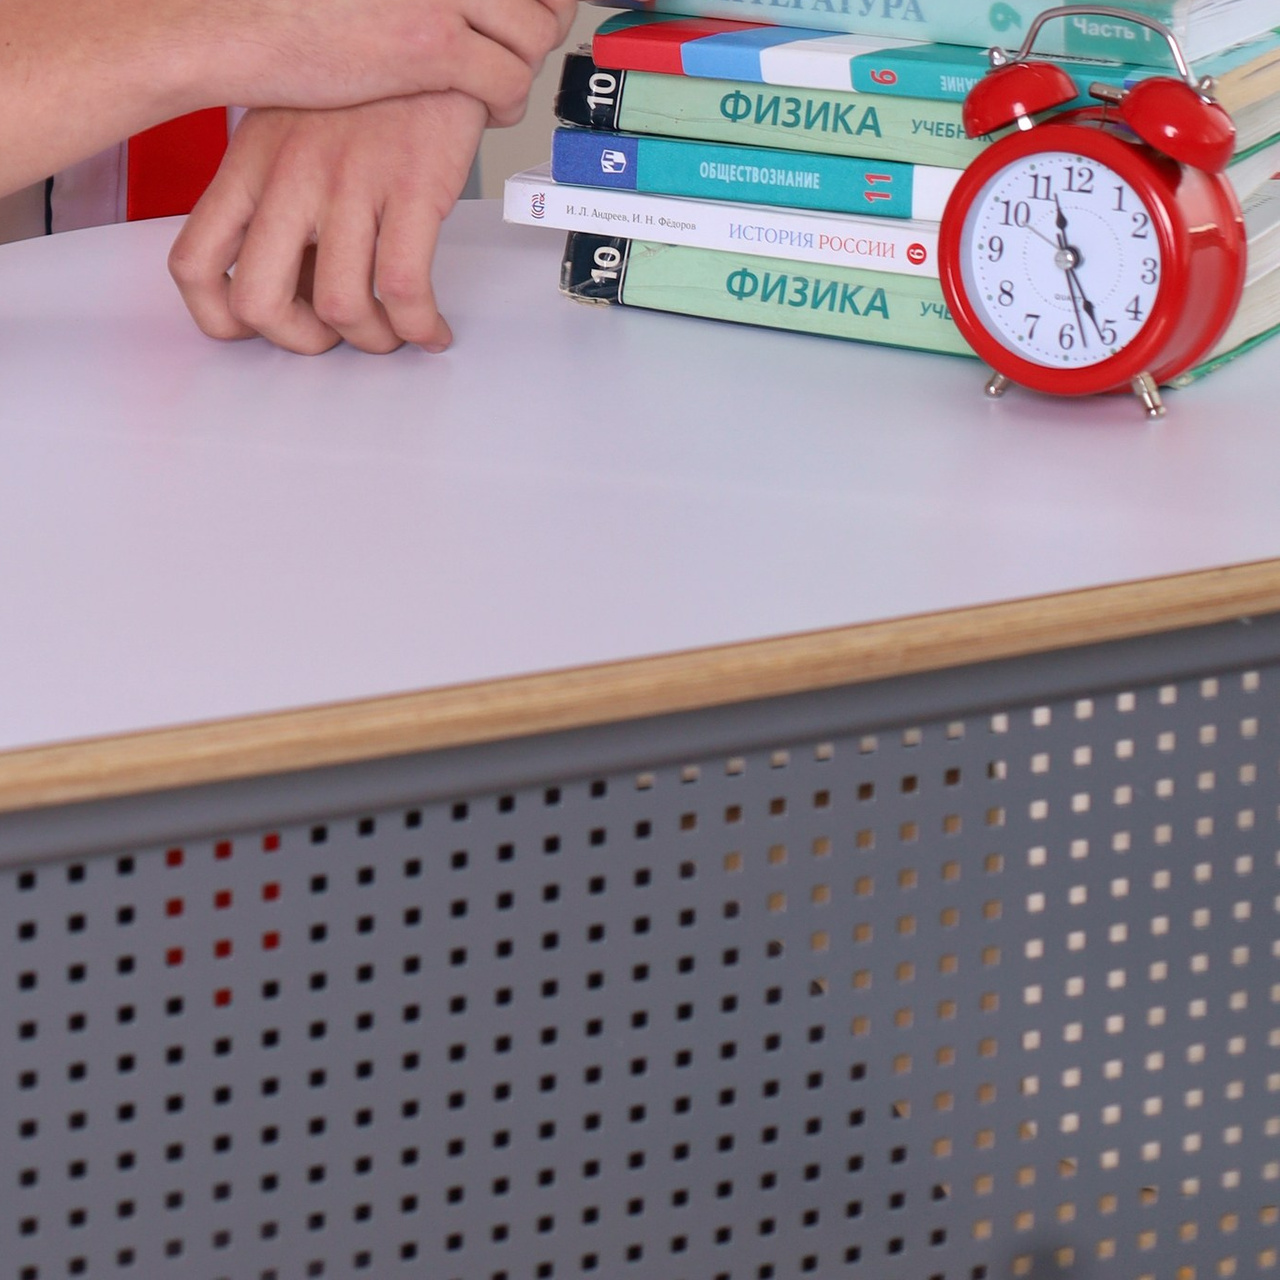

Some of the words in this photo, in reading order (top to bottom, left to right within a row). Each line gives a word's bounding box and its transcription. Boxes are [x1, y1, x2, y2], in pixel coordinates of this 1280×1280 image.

[1073, 17, 1135, 39] Часть
[1142, 25, 1151, 41] 1
[586, 72, 617, 111] 10
[720, 90, 882, 138] ФИЗИКА
[699, 161, 820, 189] ОБЩЕСТВОЗНАНИЕ
[864, 173, 892, 202] 11
[1028, 174, 1056, 201] 11
[1063, 166, 1094, 194] 12
[1112, 186, 1127, 212] 1
[566, 205, 577, 215] И.
[579, 206, 589, 217] Л.
[591, 208, 630, 223] Андреев,
[632, 213, 643, 224] И.
[645, 215, 656, 225] Н.
[658, 216, 696, 231] Фёдоров
[999, 200, 1031, 227] 10
[1132, 212, 1148, 239] 2
[729, 223, 813, 249] ИСТОРИЯ
[819, 234, 895, 258] РОССИИ
[988, 236, 1003, 262] 9
[590, 246, 620, 284] 10
[1141, 258, 1157, 284] 3
[726, 268, 889, 319] ФИЗИКА
[998, 280, 1014, 307] 8
[1125, 295, 1143, 322] 4
[1024, 313, 1041, 340] 7
[1059, 324, 1074, 350] 6
[1101, 319, 1117, 345] 5
